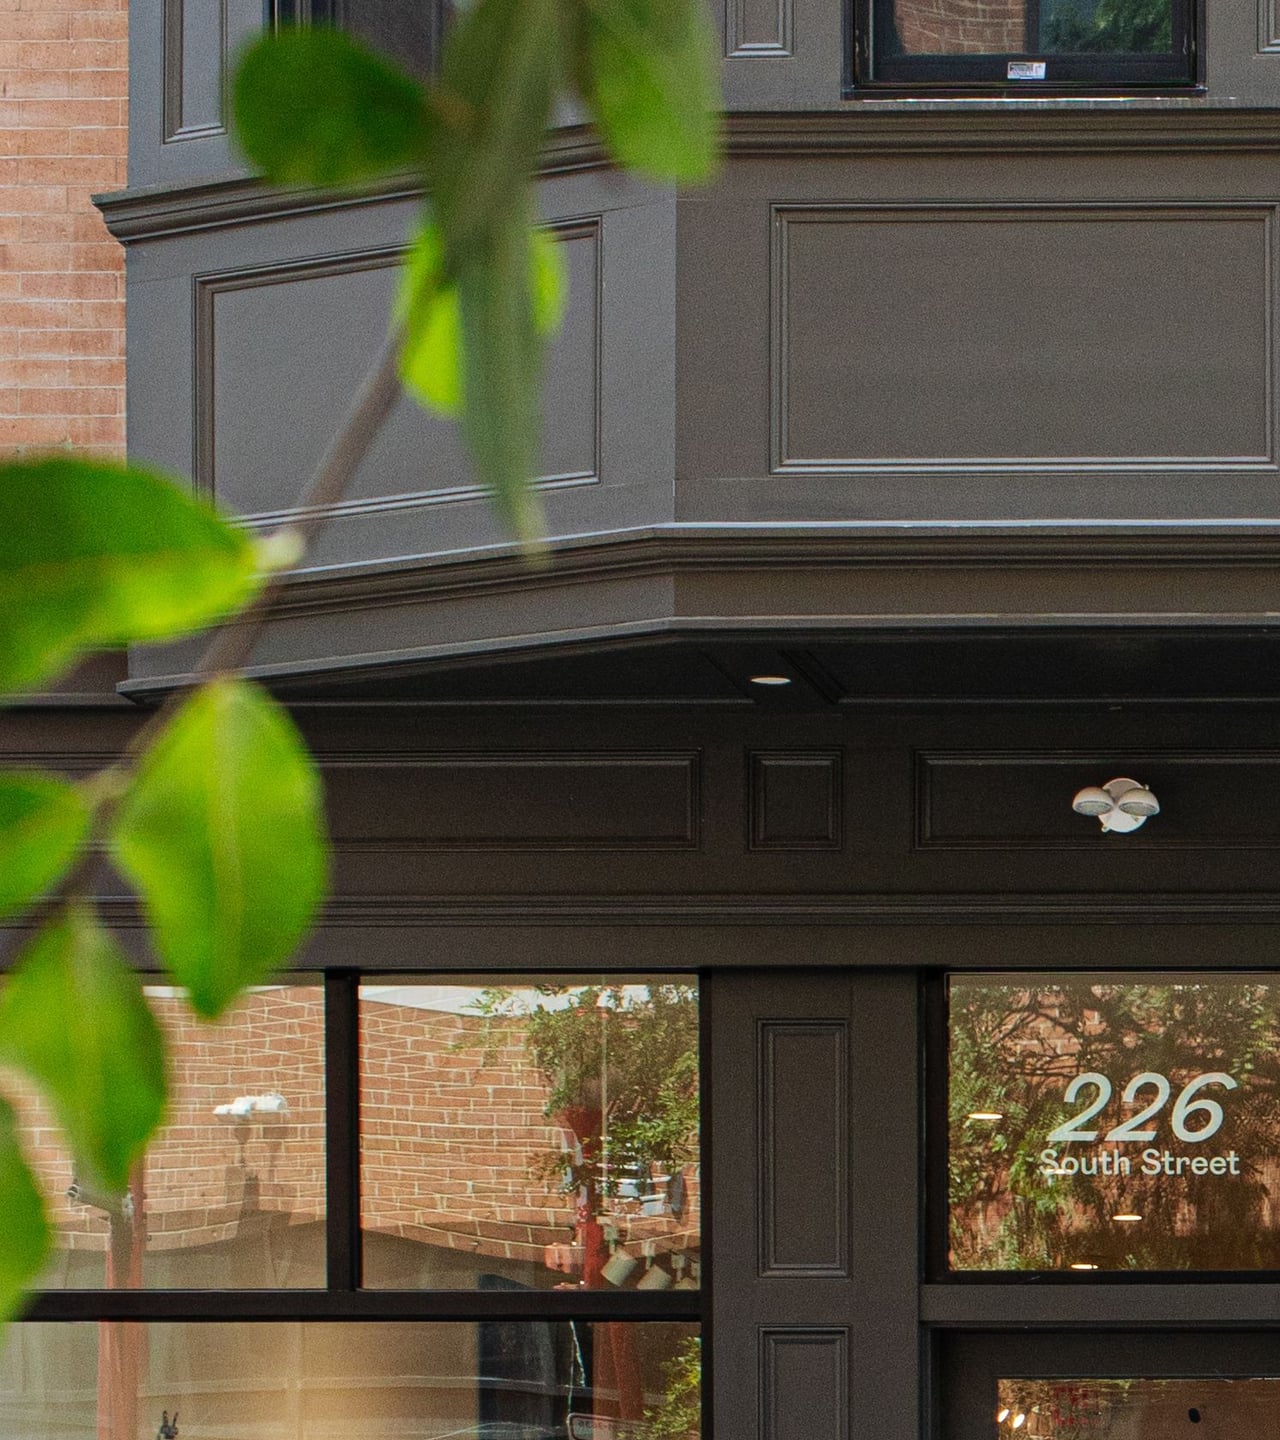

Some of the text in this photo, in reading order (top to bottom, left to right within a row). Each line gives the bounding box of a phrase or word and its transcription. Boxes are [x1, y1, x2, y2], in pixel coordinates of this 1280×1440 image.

[1046, 1072, 1238, 1143] 226
[1040, 1148, 1240, 1176] South Street
